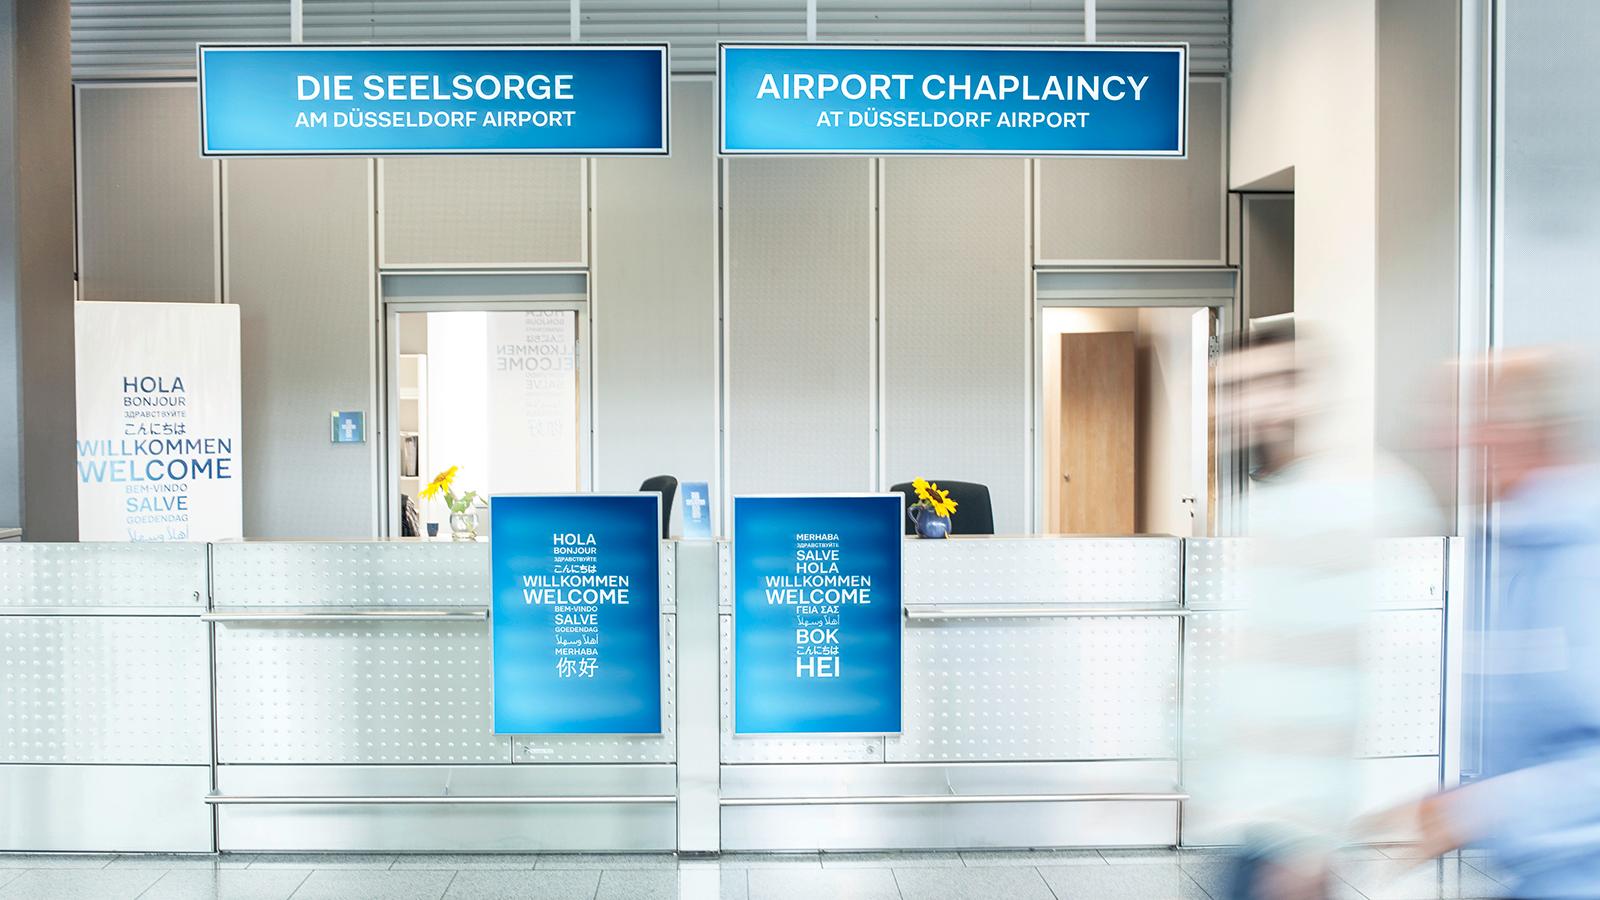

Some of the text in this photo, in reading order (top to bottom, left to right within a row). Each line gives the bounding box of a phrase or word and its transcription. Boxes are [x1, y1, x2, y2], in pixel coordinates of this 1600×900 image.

[298, 75, 573, 100] DIE SEELSORGE
[756, 74, 1148, 100] AIRPORT CHAPLAINCY
[295, 108, 575, 127] AM DÜSSELDORF AIRPORT
[817, 108, 1089, 128] AT DÜSSELDORF AIRPORT
[124, 377, 185, 392] HOLA
[124, 396, 186, 406] BONJOUR
[125, 423, 186, 435] こんにちは
[77, 438, 231, 456] WILLKOMMEN
[78, 458, 231, 482] WELCOME
[126, 484, 187, 494] BEM-VINDO
[127, 496, 187, 512] SALVE
[127, 514, 188, 524] GOEDENDAG
[554, 534, 596, 545] HOLA
[797, 550, 839, 561] SALVE
[554, 565, 596, 573] こんにちは
[796, 562, 839, 573] HOLA
[523, 576, 628, 587] WILLKOMMEN
[766, 576, 870, 587] WILLKOMMEN
[523, 589, 628, 604] WELCOME
[766, 589, 870, 604] WELCOME
[797, 606, 839, 614] ΓΕΙΑ ΣΑΣ
[555, 614, 597, 625] SALVE
[797, 629, 838, 644] BOK
[797, 646, 839, 655] こんにちは
[556, 657, 598, 678] 你好
[797, 657, 839, 677] HEI
